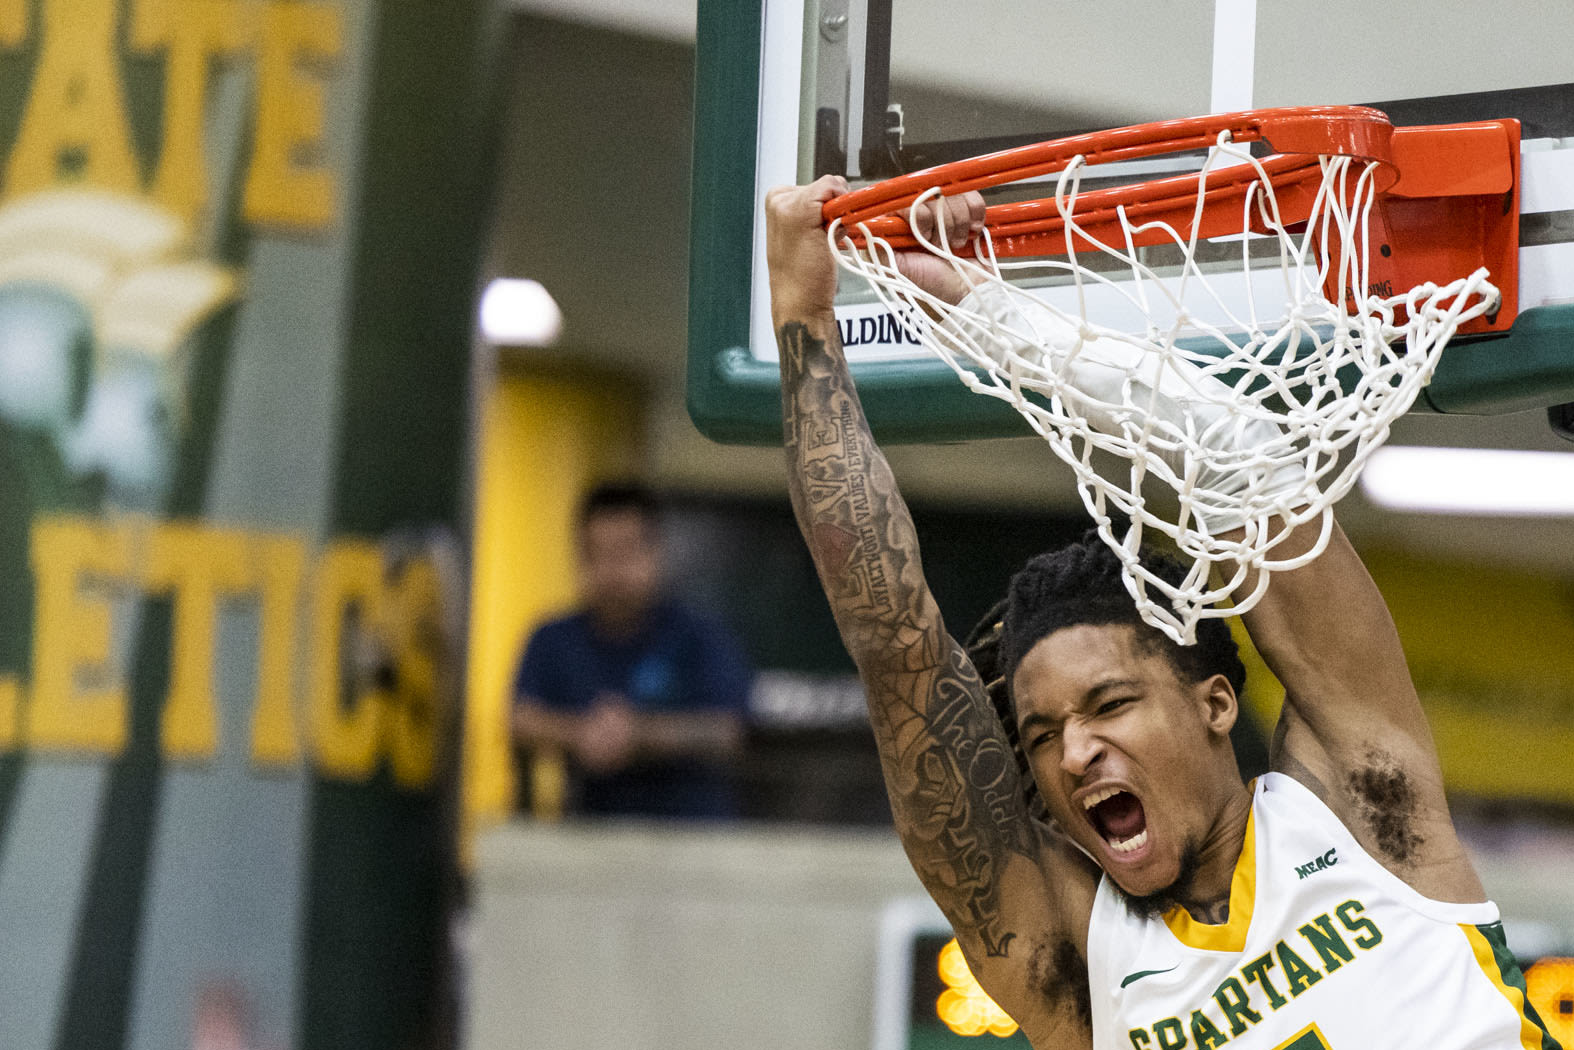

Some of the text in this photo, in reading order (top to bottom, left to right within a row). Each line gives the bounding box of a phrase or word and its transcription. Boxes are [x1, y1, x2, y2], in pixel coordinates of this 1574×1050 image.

[0, 0, 340, 226] ATE
[0, 512, 440, 786] ETICS
[1294, 847, 1338, 880] MEAC
